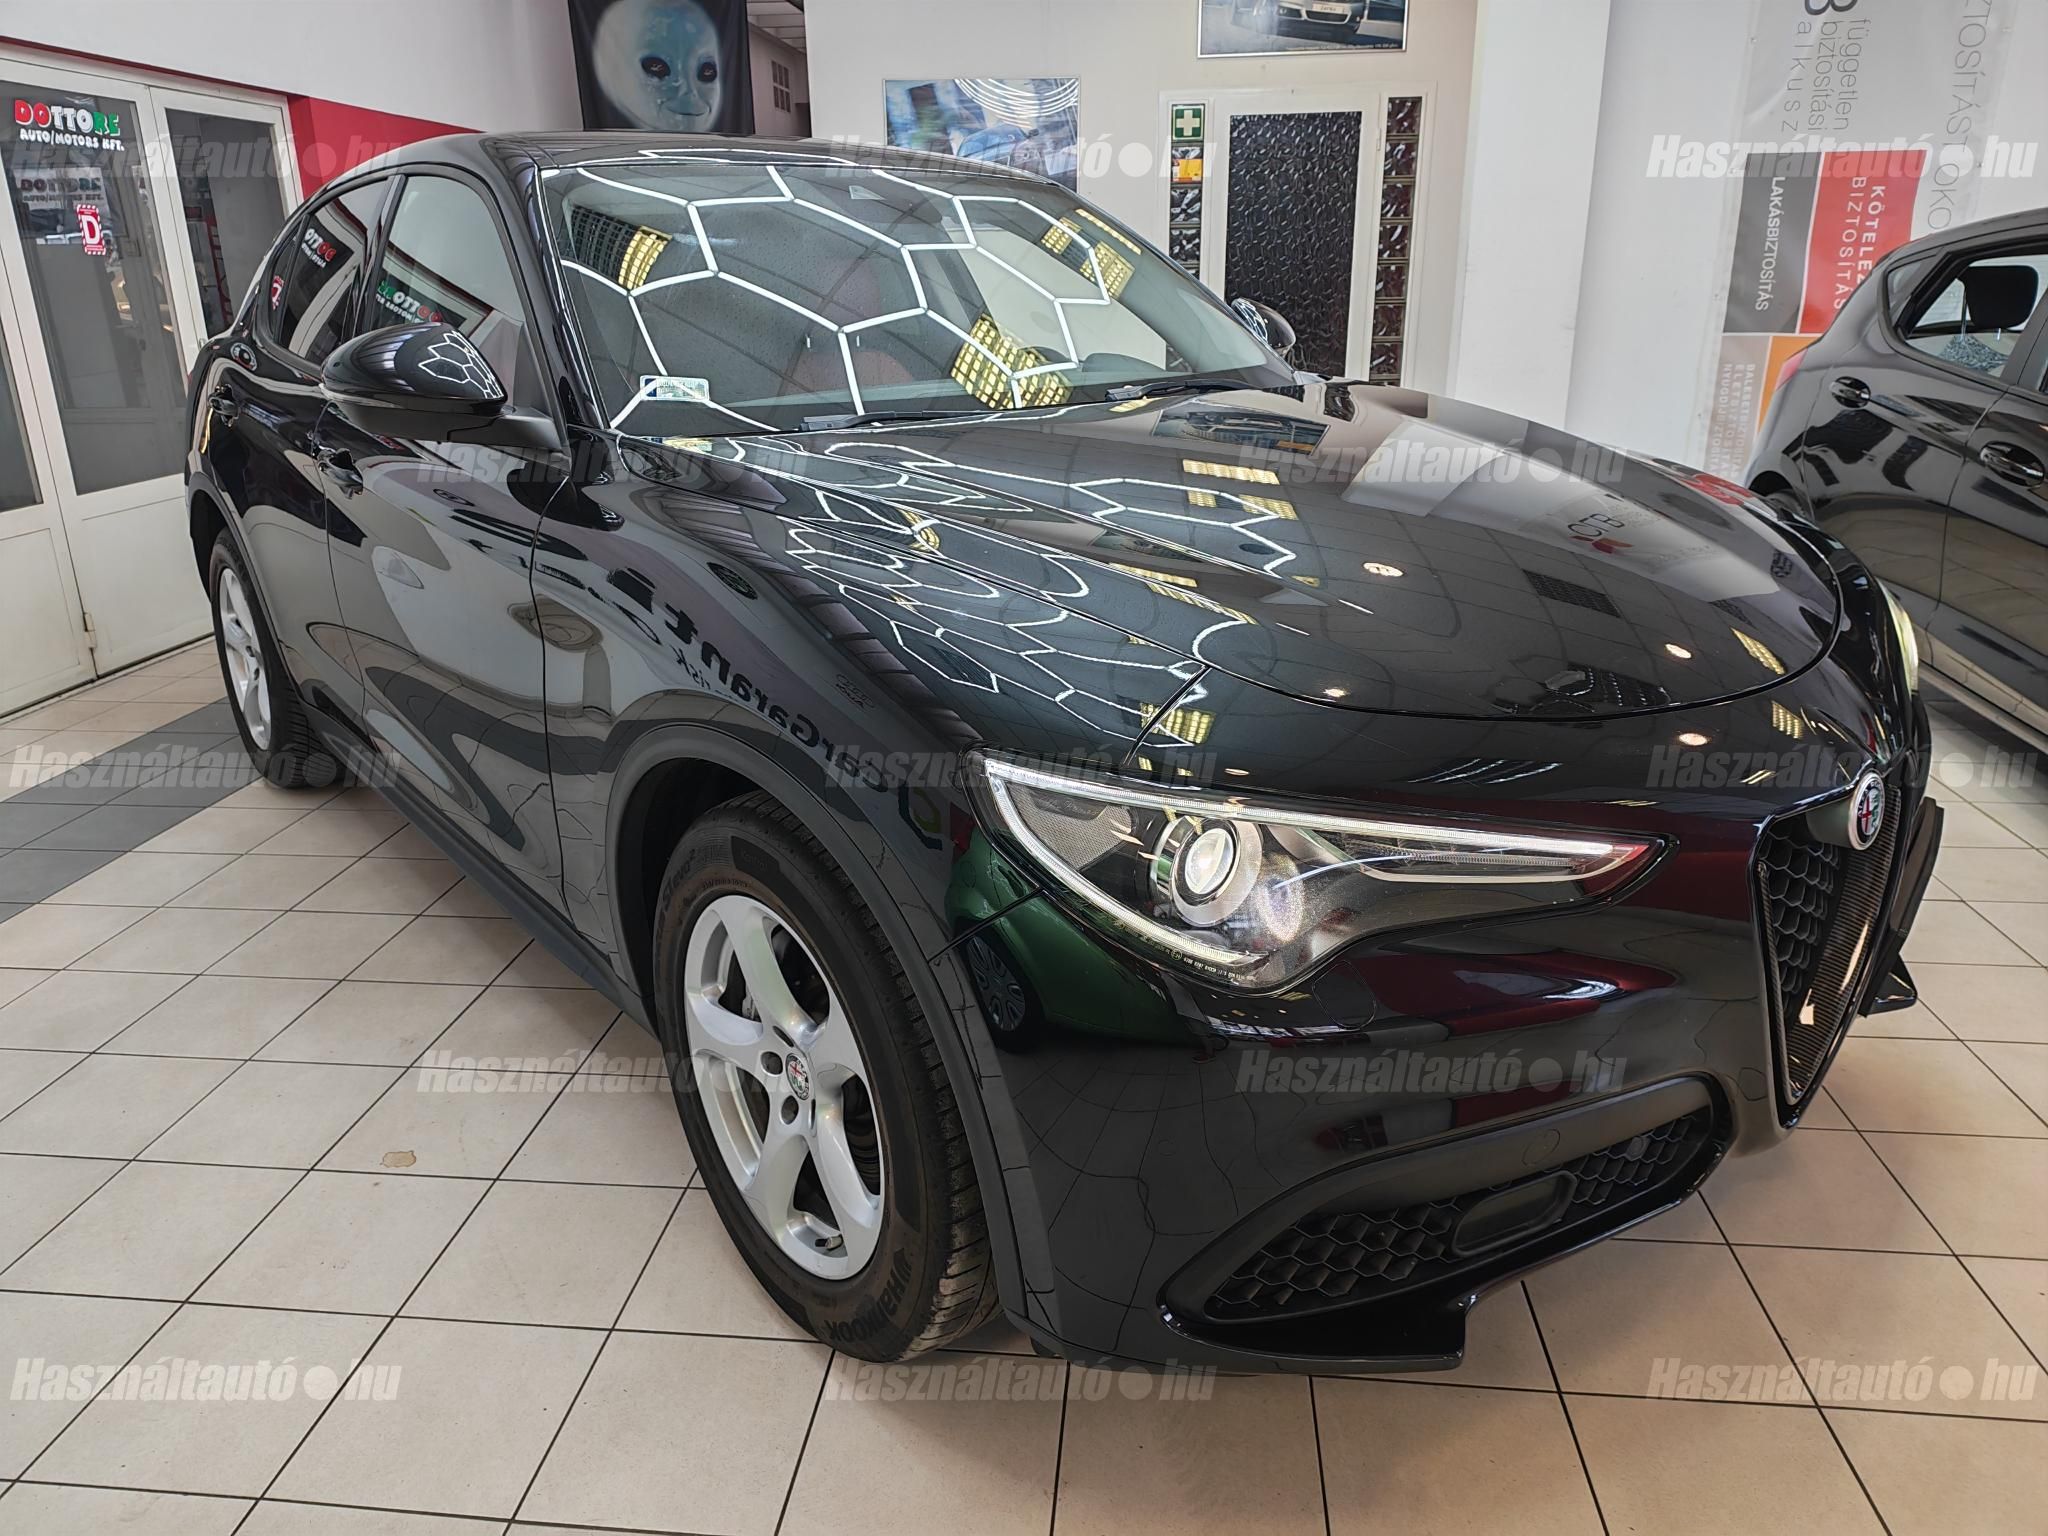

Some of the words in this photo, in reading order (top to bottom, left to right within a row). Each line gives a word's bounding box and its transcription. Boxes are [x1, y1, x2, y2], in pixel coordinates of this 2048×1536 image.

[15, 99, 121, 137] DOTTORE
[1808, 21, 1845, 131] biztosítási
[1832, 19, 1871, 130] független
[20, 128, 99, 149] AUTO/MOTORS
[102, 138, 125, 151] KFT.
[1755, 177, 1786, 311] LAKÁSBIZTOSÍTÁS
[1834, 177, 1867, 310] BIZTOSÍTÁS
